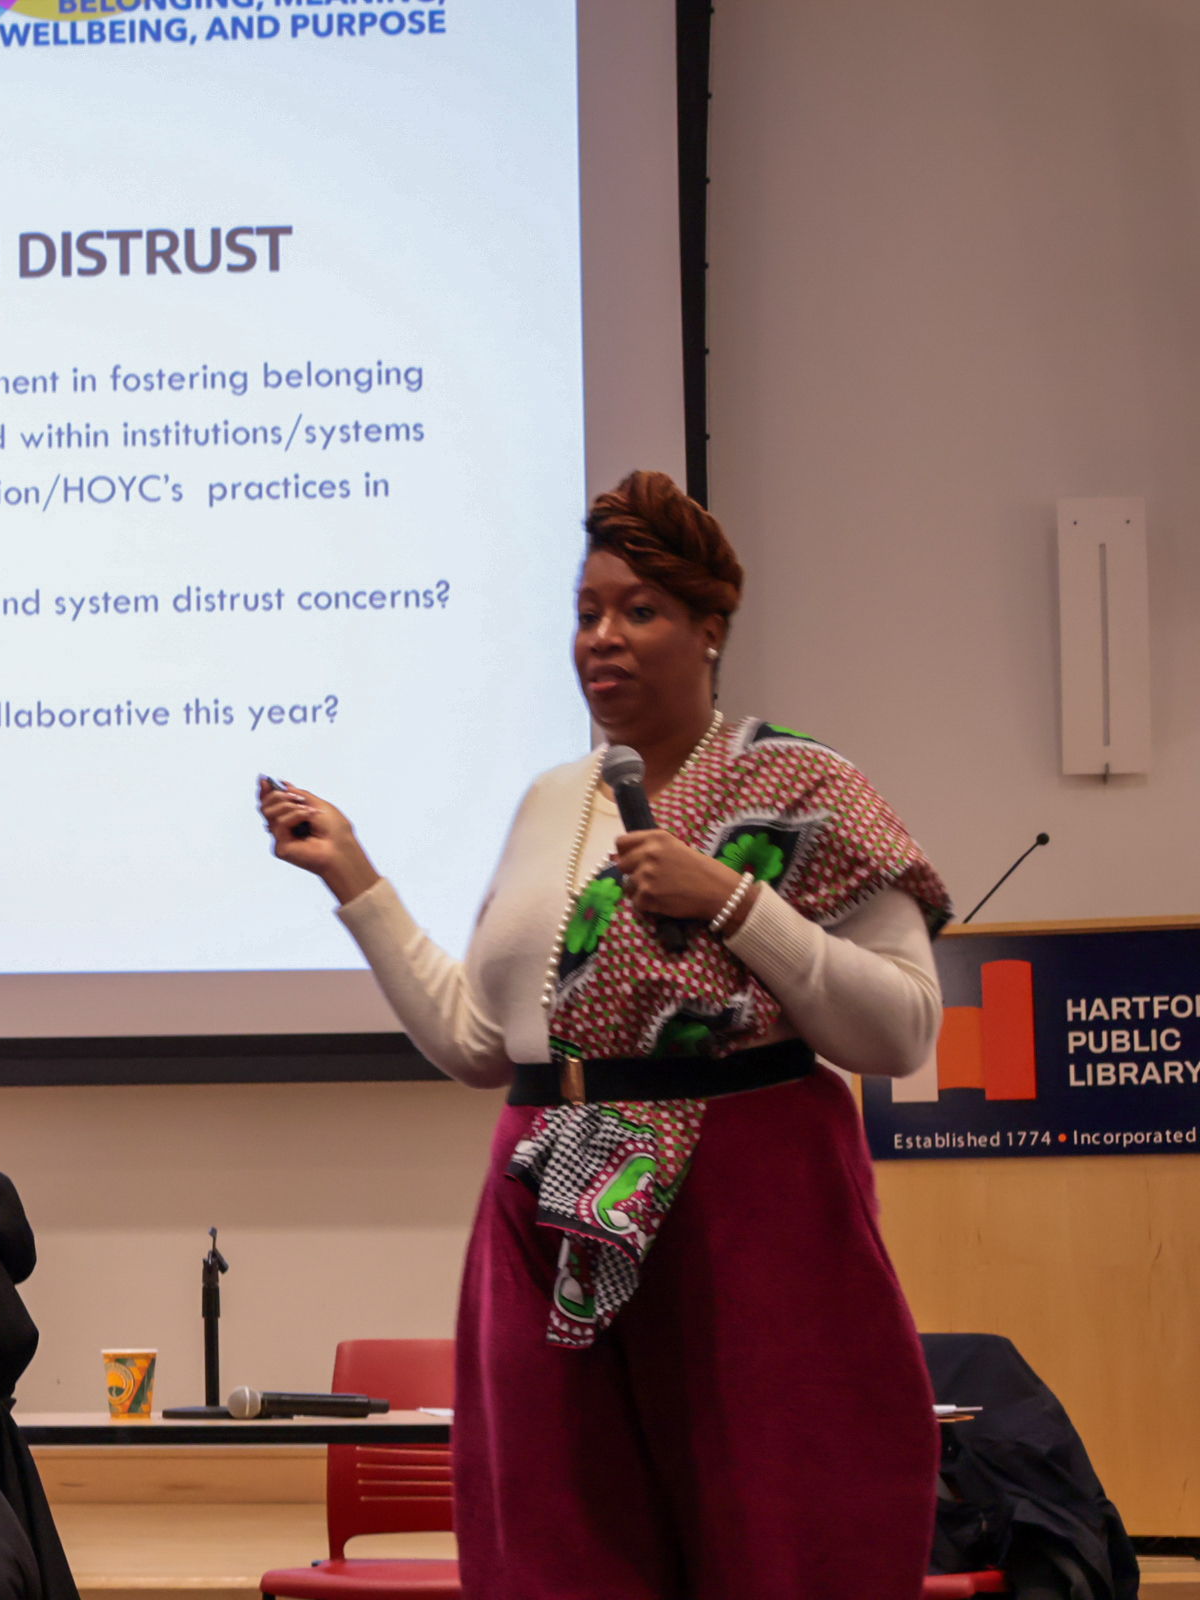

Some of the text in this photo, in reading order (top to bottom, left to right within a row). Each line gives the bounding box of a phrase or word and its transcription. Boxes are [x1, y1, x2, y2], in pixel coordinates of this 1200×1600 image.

[205, 14, 280, 41] AND
[290, 9, 447, 38] PURPOSE
[18, 224, 294, 280] DISTRUST
[71, 366, 97, 394] in
[109, 363, 249, 397] fostering
[262, 359, 424, 394] belonging
[19, 421, 110, 450] within
[122, 412, 425, 453] institutions/systems
[208, 472, 351, 509] practices
[363, 470, 390, 499] in
[54, 591, 159, 623] system
[172, 584, 286, 614] distrust
[296, 578, 451, 612] concerns?
[182, 697, 235, 726] this
[247, 693, 339, 732] year?
[1066, 994, 1200, 1022] HARTFO
[1068, 1028, 1182, 1054] PUBLIC
[1069, 1060, 1200, 1087] LIBRARY
[894, 1127, 1197, 1149] Established 1774 Incorporated
